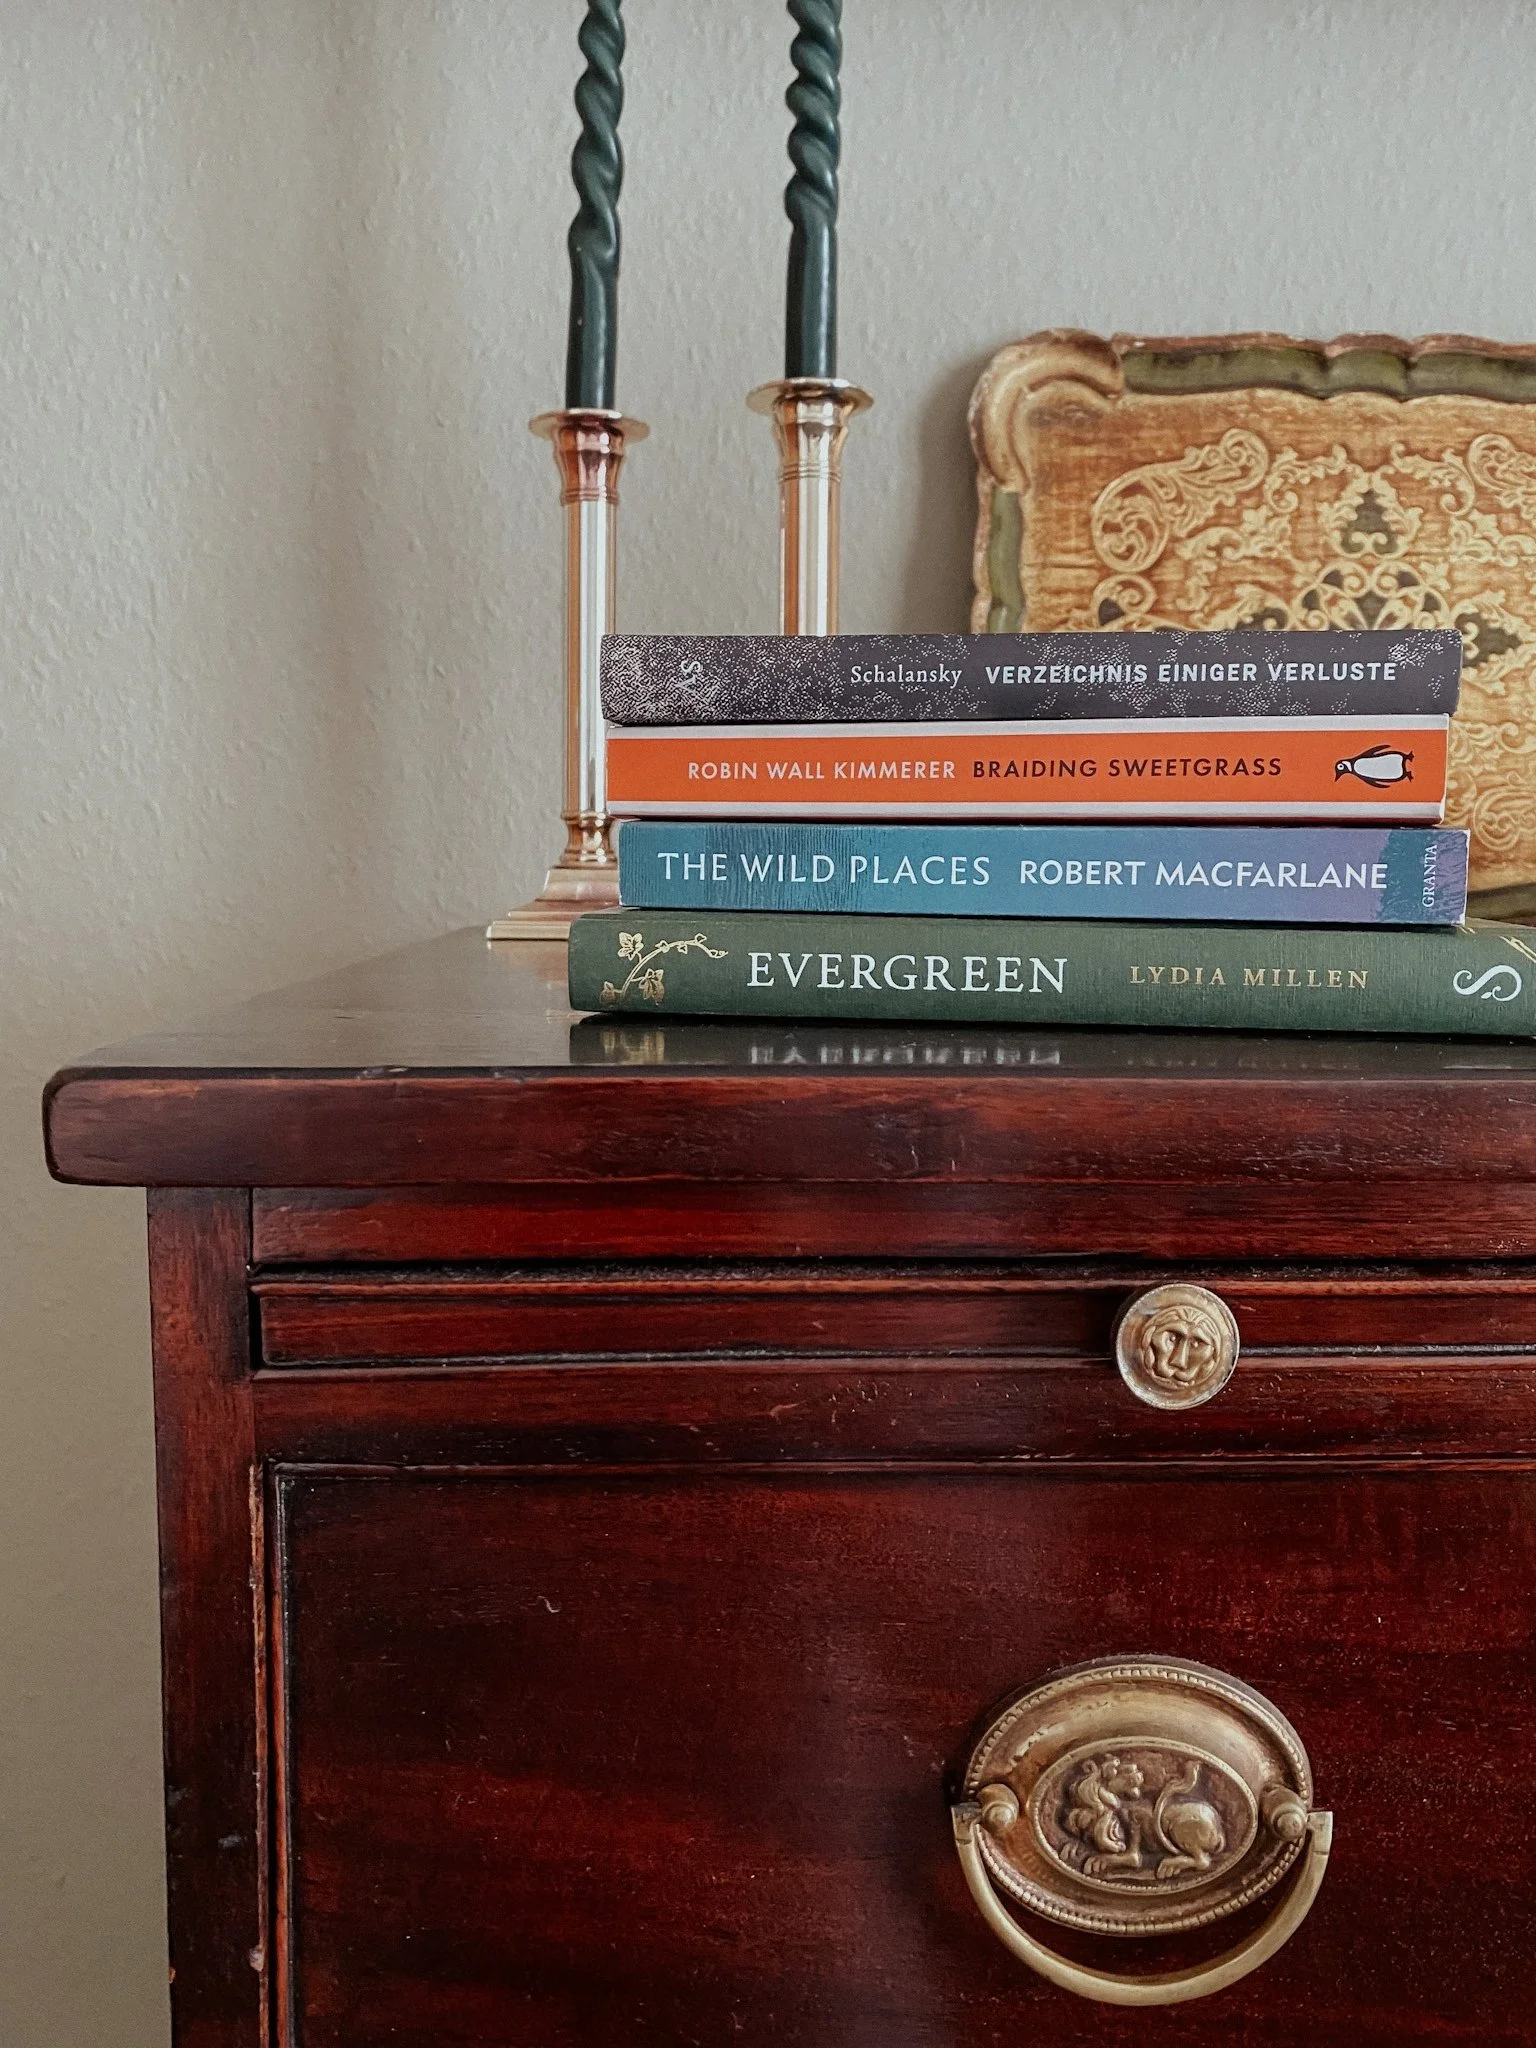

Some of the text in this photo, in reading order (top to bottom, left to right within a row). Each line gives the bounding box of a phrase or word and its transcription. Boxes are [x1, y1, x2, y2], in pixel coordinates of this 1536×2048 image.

[850, 662, 1397, 685] Schalansky VERZEICHNIS EINIGER VERLUSTE
[687, 757, 1282, 780] ROBIN WALL KIMMERER BRAIDING SWEETGRASS
[657, 852, 1388, 889] THE WILD PLACES ROBERT MACFARLANE
[1422, 844, 1438, 908] GRANTA
[746, 951, 1369, 995] EVERGREEN LYDIA MILLEN
